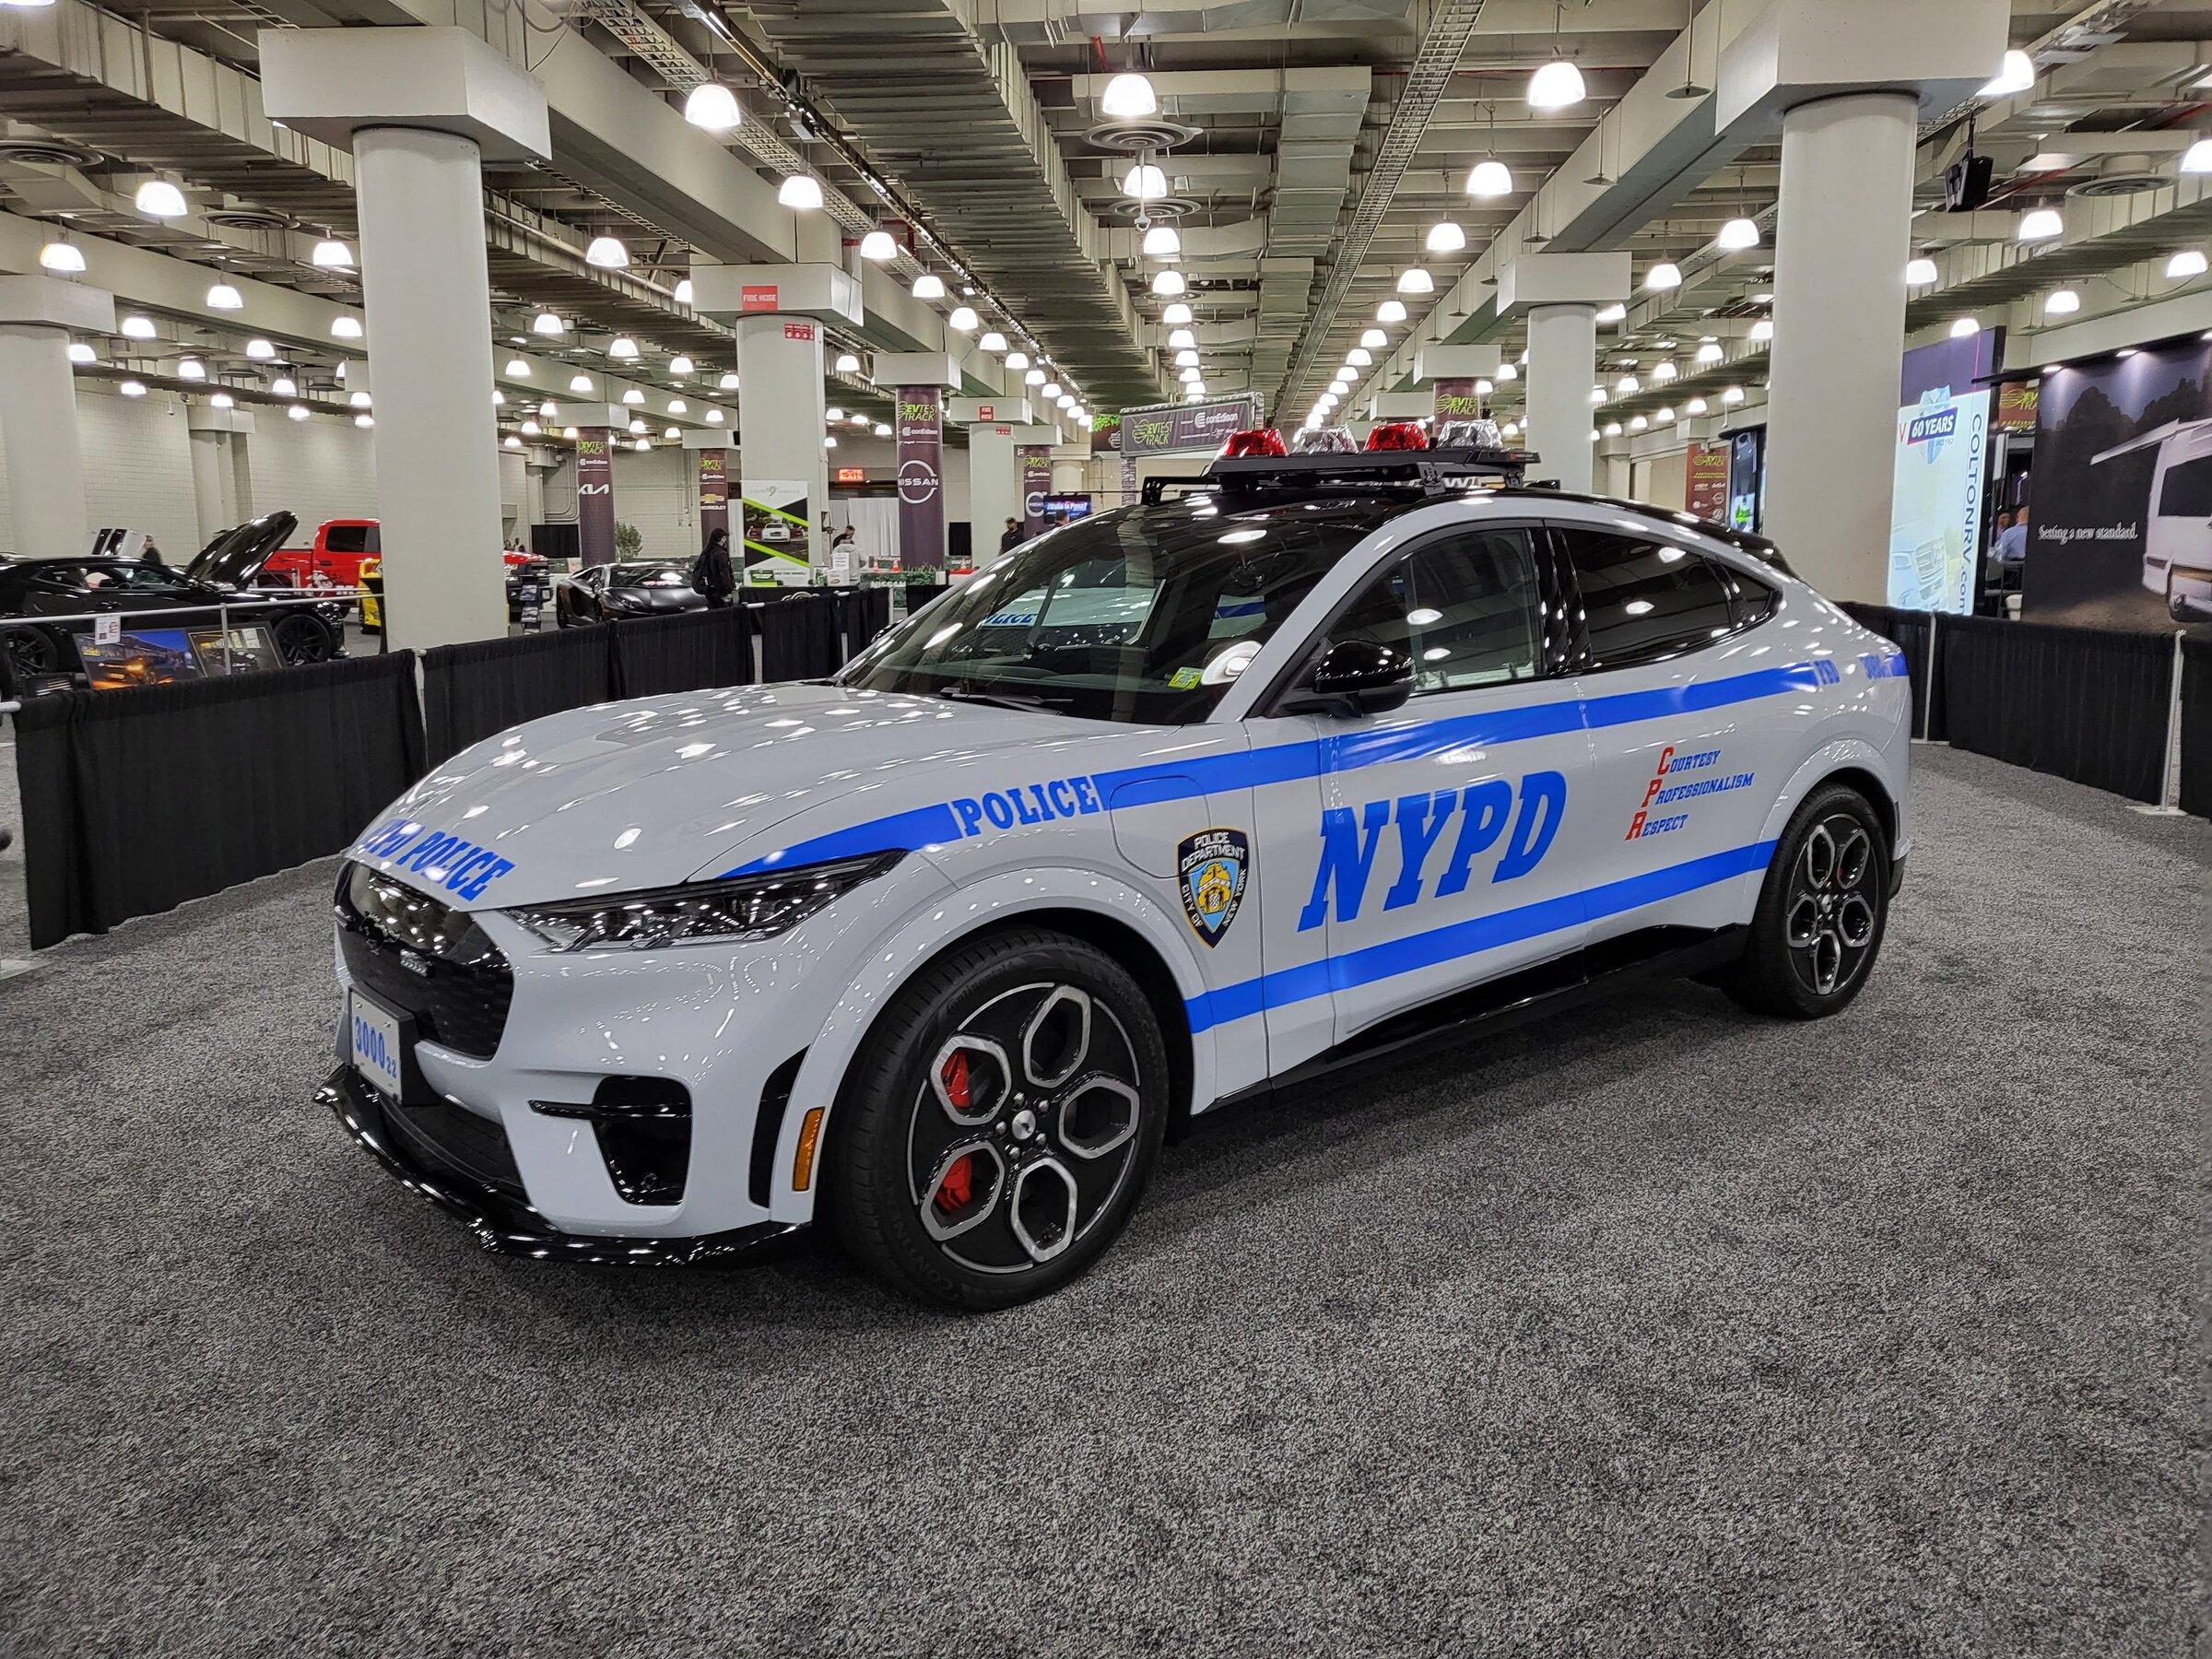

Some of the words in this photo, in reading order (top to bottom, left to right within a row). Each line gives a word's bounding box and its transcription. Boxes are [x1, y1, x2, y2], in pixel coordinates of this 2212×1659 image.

[743, 294, 758, 302] FIRE
[759, 294, 777, 302] HOSE
[904, 412, 935, 422] TRACK
[1911, 419, 1925, 440] 60
[1924, 414, 1955, 438] YEARS
[1146, 432, 1169, 445] TRACK
[899, 477, 939, 486] ISSAN
[2038, 524, 2069, 546] Setting
[2075, 527, 2095, 540] new
[2095, 522, 2138, 540] standard.
[951, 775, 1100, 837] POLICE
[1194, 832, 1231, 850] POLICE
[1297, 771, 1567, 933] NYPD
[395, 830, 516, 902] POLICE
[1181, 844, 1246, 873] DEPARTMENT
[1181, 883, 1195, 912] CITY
[1190, 912, 1204, 928] OF
[1222, 899, 1239, 927] NEW
[1234, 868, 1247, 898] YORK
[354, 1016, 386, 1069] 3000
[386, 1055, 398, 1079] 22
